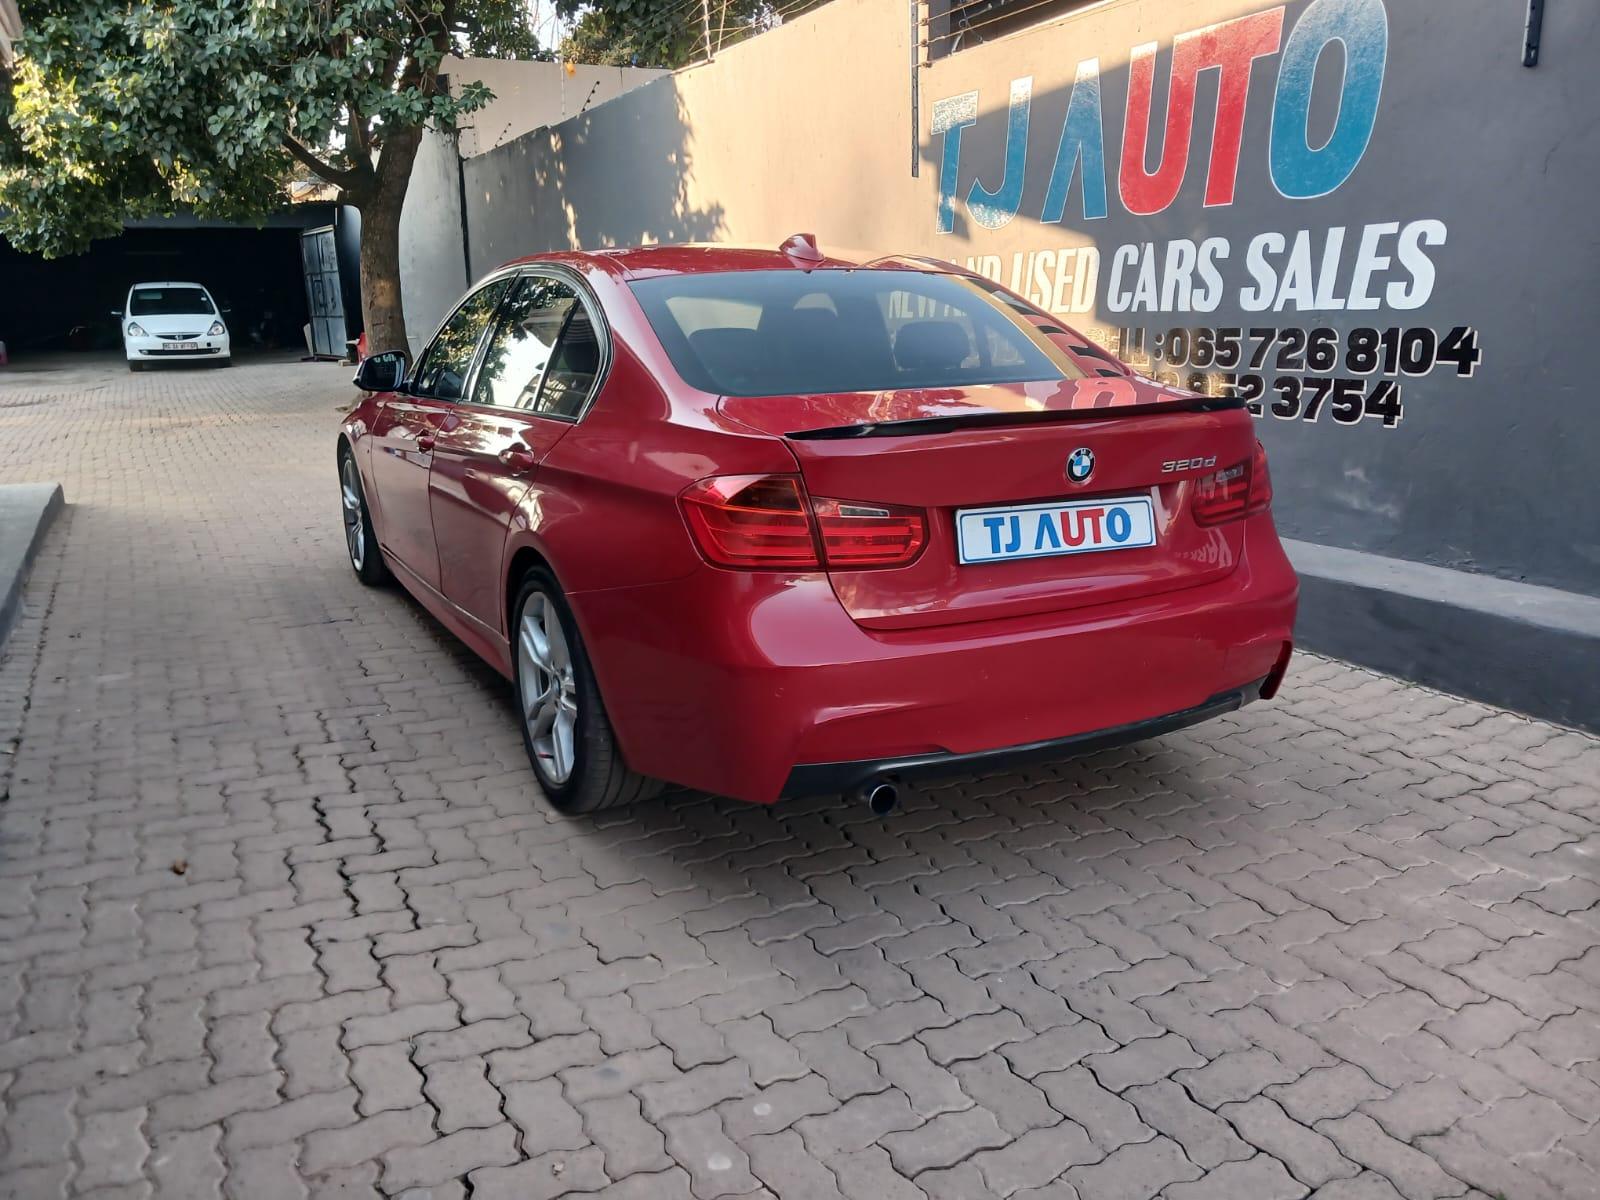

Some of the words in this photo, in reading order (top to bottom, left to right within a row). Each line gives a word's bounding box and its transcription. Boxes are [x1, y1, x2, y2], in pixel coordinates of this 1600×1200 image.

[931, 76, 1033, 235] TJ
[1040, 0, 1388, 224] AUTO
[1009, 246, 1100, 314] USED
[1106, 237, 1231, 313] CARS
[1240, 219, 1447, 312] SALES
[1248, 327, 1339, 374] 726
[1345, 325, 1481, 378] 8104
[1271, 376, 1404, 428] 3754
[1161, 456, 1217, 473] 320d
[983, 515, 1022, 554] TJ
[1034, 507, 1132, 551] AUTO
